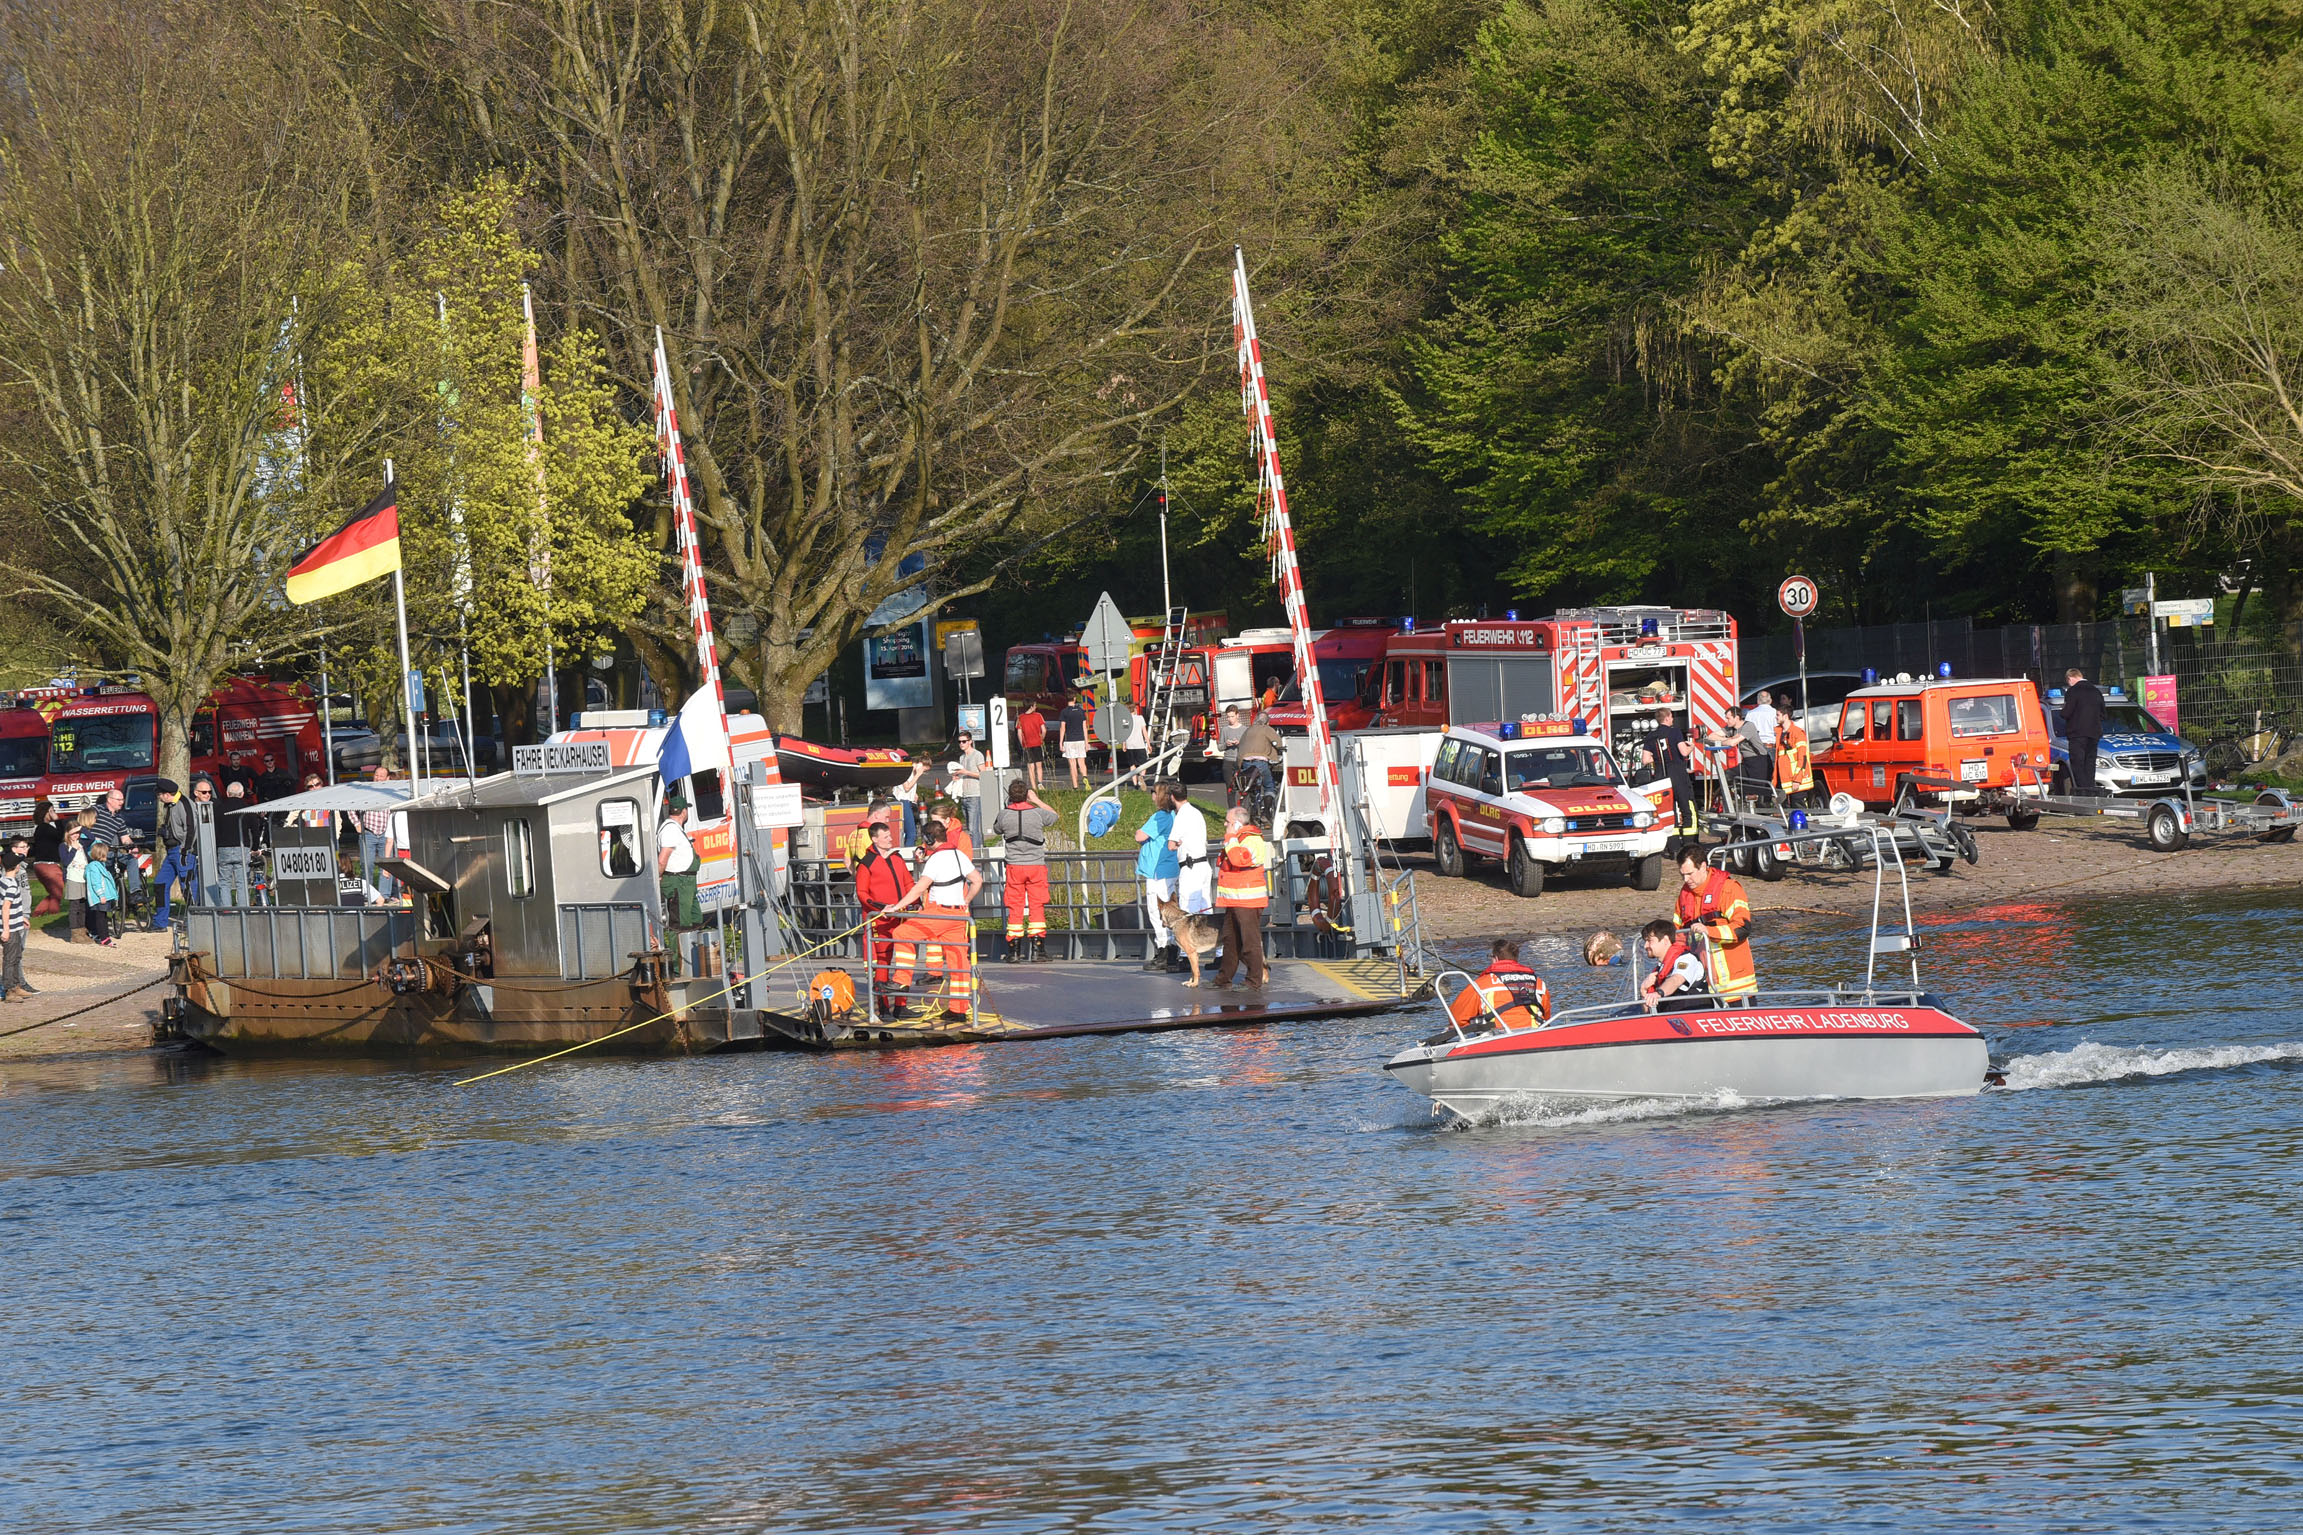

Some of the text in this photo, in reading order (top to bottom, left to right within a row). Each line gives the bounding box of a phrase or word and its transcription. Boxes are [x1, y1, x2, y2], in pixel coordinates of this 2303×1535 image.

[1787, 586, 1809, 606] 30
[1463, 629, 1534, 645] FEUERWEHR 112
[1100, 691, 1132, 703] Nruf
[62, 705, 147, 717] WASSERRETTUNG
[994, 704, 1004, 726] 2
[222, 718, 258, 730] FEUERWEHR
[1524, 724, 1570, 736] DLRG
[223, 730, 255, 742] MANNHEIM
[515, 745, 609, 771] FÄHRE NECKARHAUSEN
[1968, 764, 1980, 772] HD
[1963, 770, 1987, 779] UC 610
[51, 780, 115, 792] FEUER WEHR
[1479, 803, 1501, 819] DLRG
[1567, 803, 1629, 813] DLRG
[703, 832, 728, 849] DLRG
[1587, 843, 1596, 851] HD
[281, 851, 327, 873] 04808180
[1696, 1013, 1910, 1033] FEUERWEHR LADENBURG
